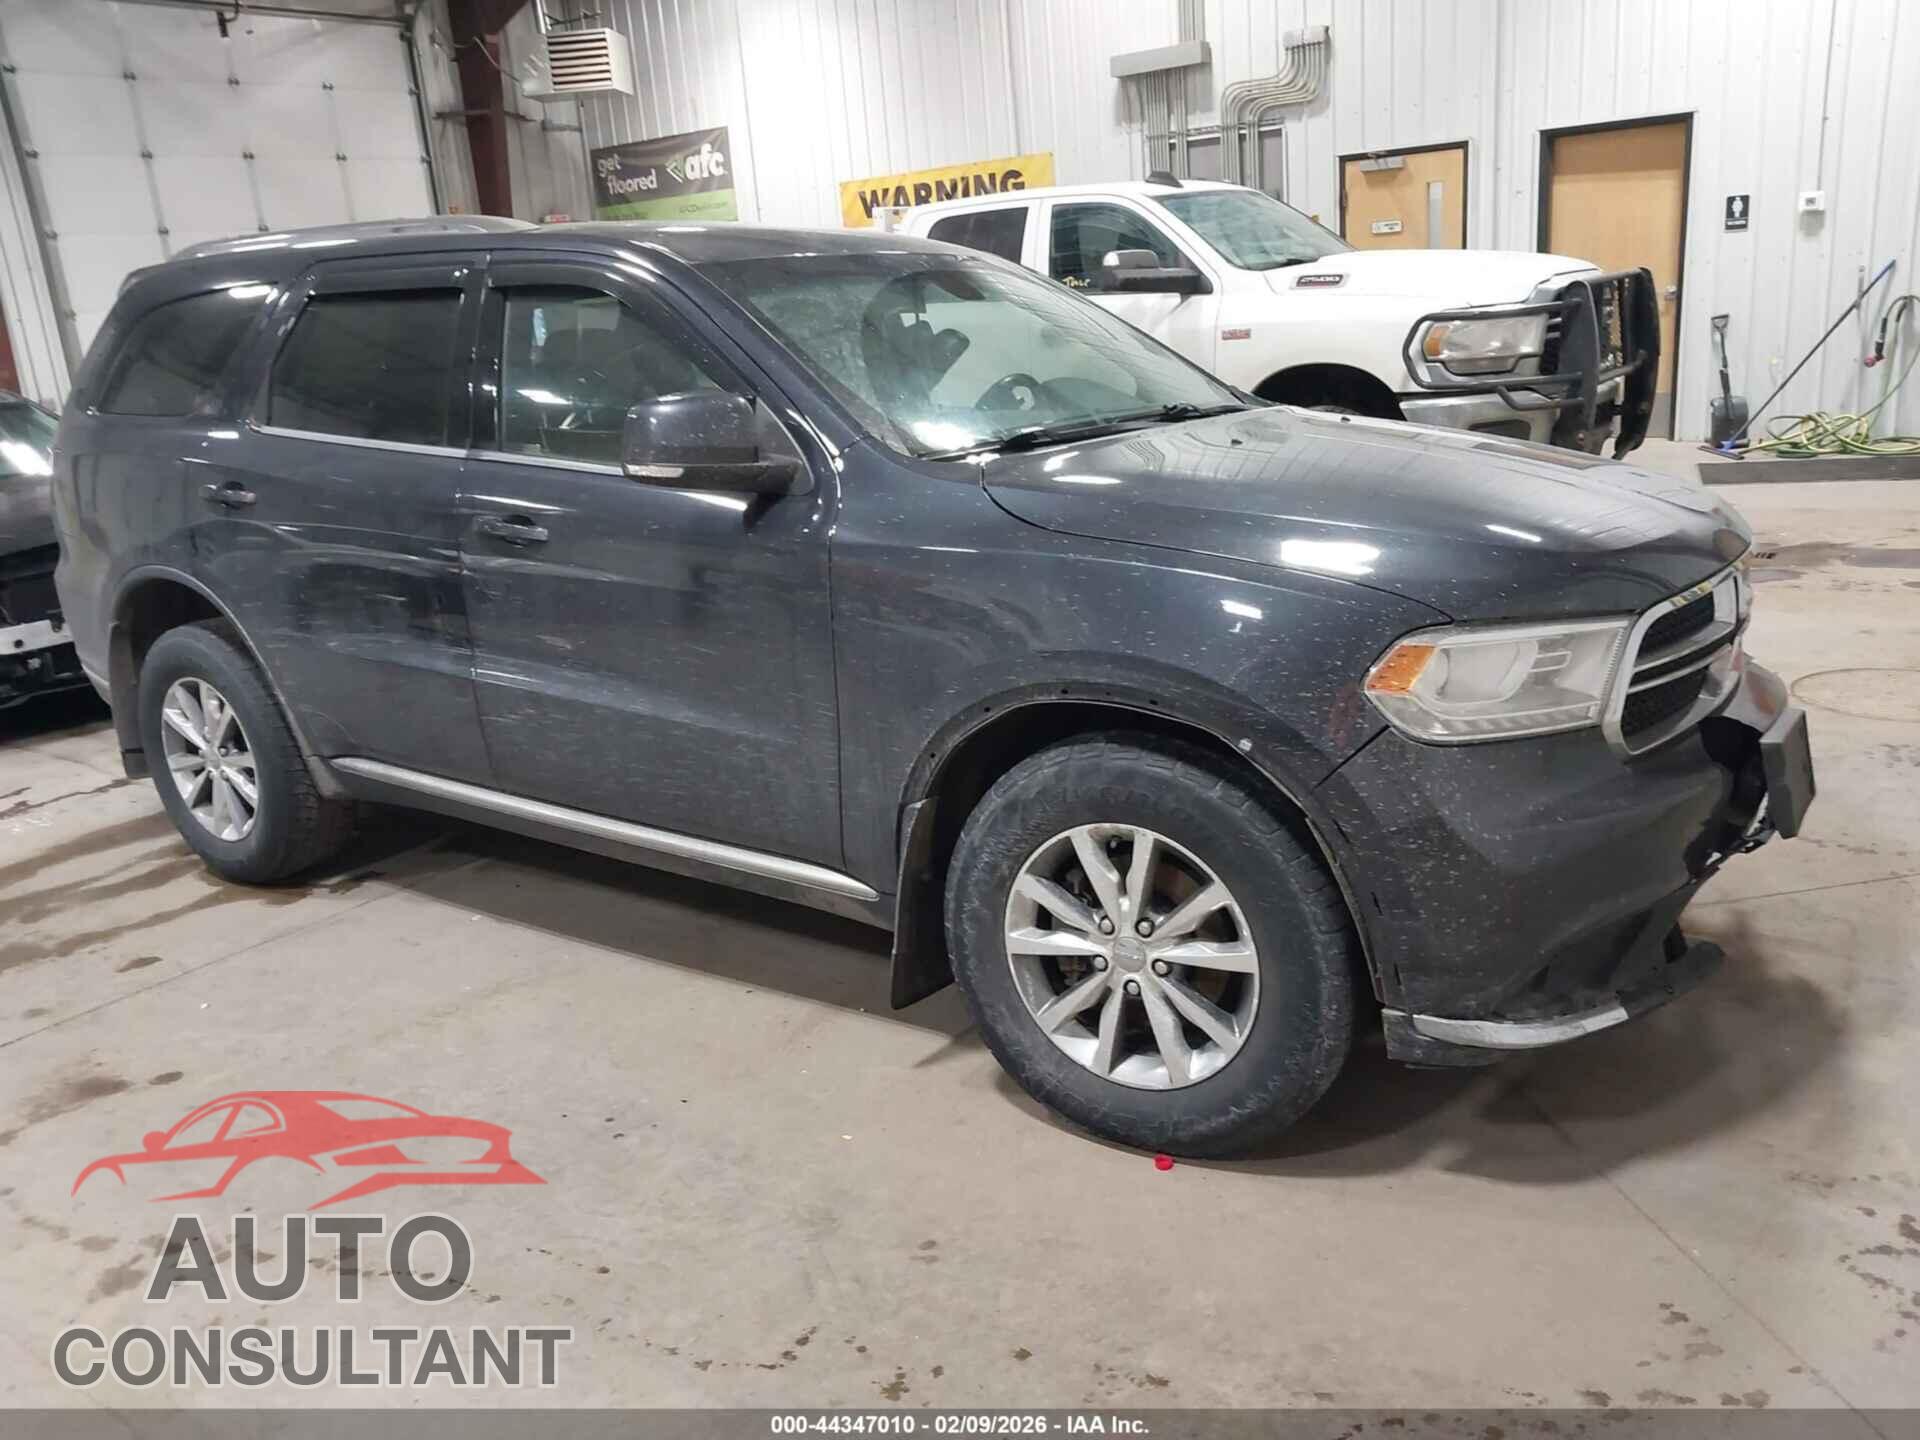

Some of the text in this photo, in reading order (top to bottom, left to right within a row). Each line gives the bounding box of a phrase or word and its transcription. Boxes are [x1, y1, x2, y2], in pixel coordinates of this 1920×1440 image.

[597, 153, 623, 178] get
[685, 143, 724, 181] afc
[607, 168, 658, 196] floored
[858, 169, 1026, 219] WARNING
